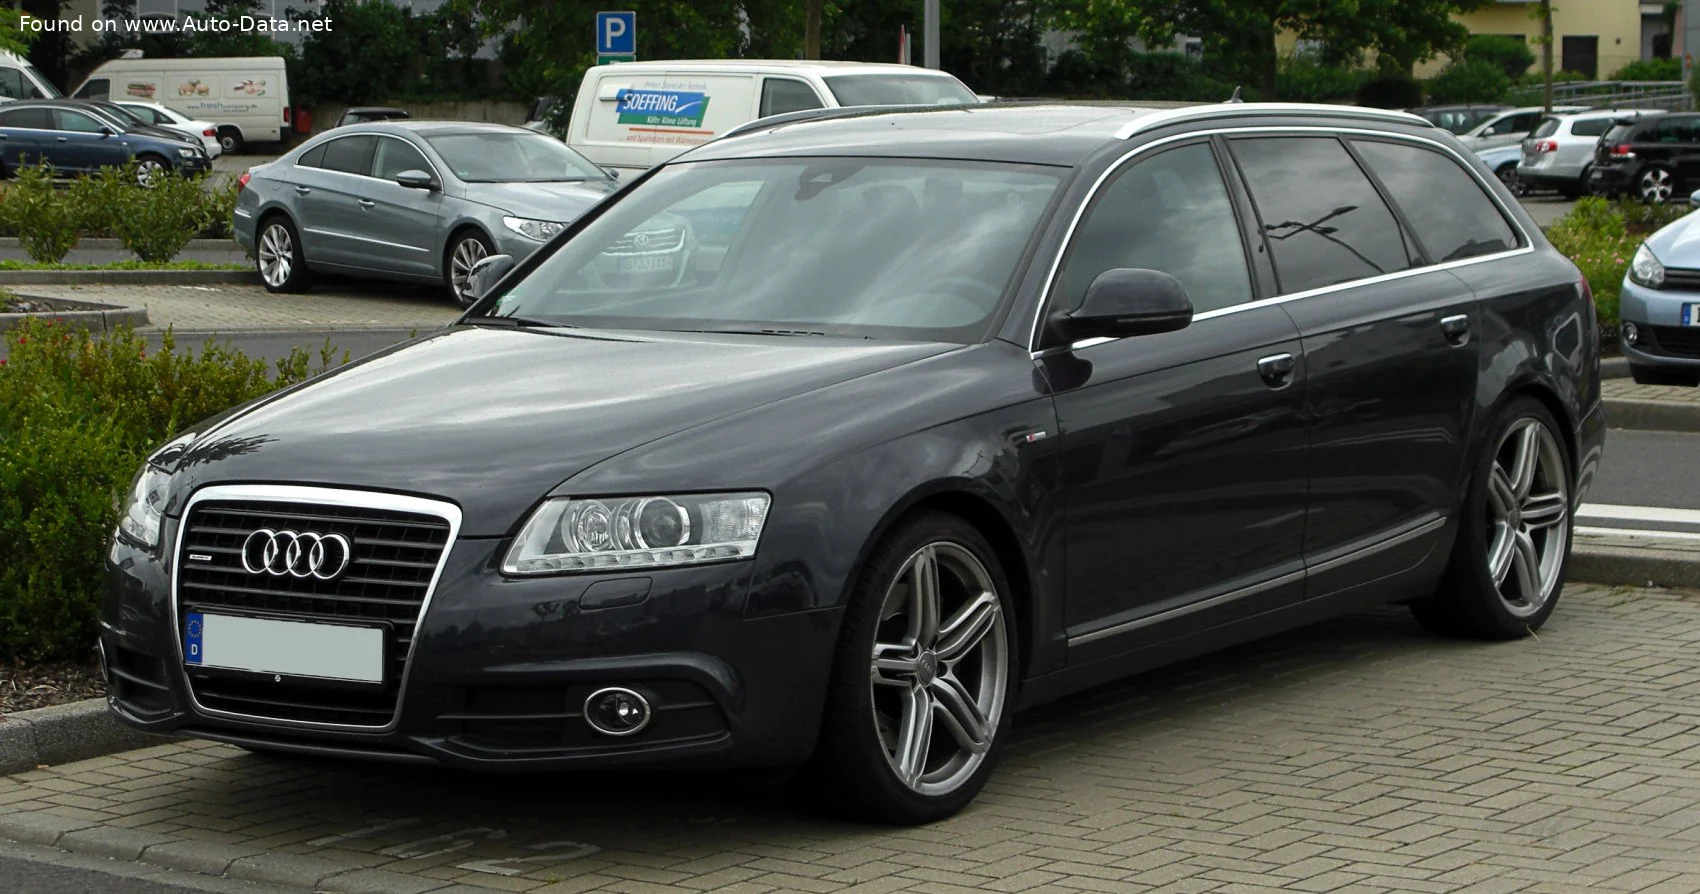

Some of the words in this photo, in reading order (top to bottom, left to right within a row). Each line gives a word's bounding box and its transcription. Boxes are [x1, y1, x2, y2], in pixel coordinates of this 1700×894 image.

[606, 17, 625, 48] P
[623, 93, 678, 112] SOEFFING
[191, 643, 198, 656] D
